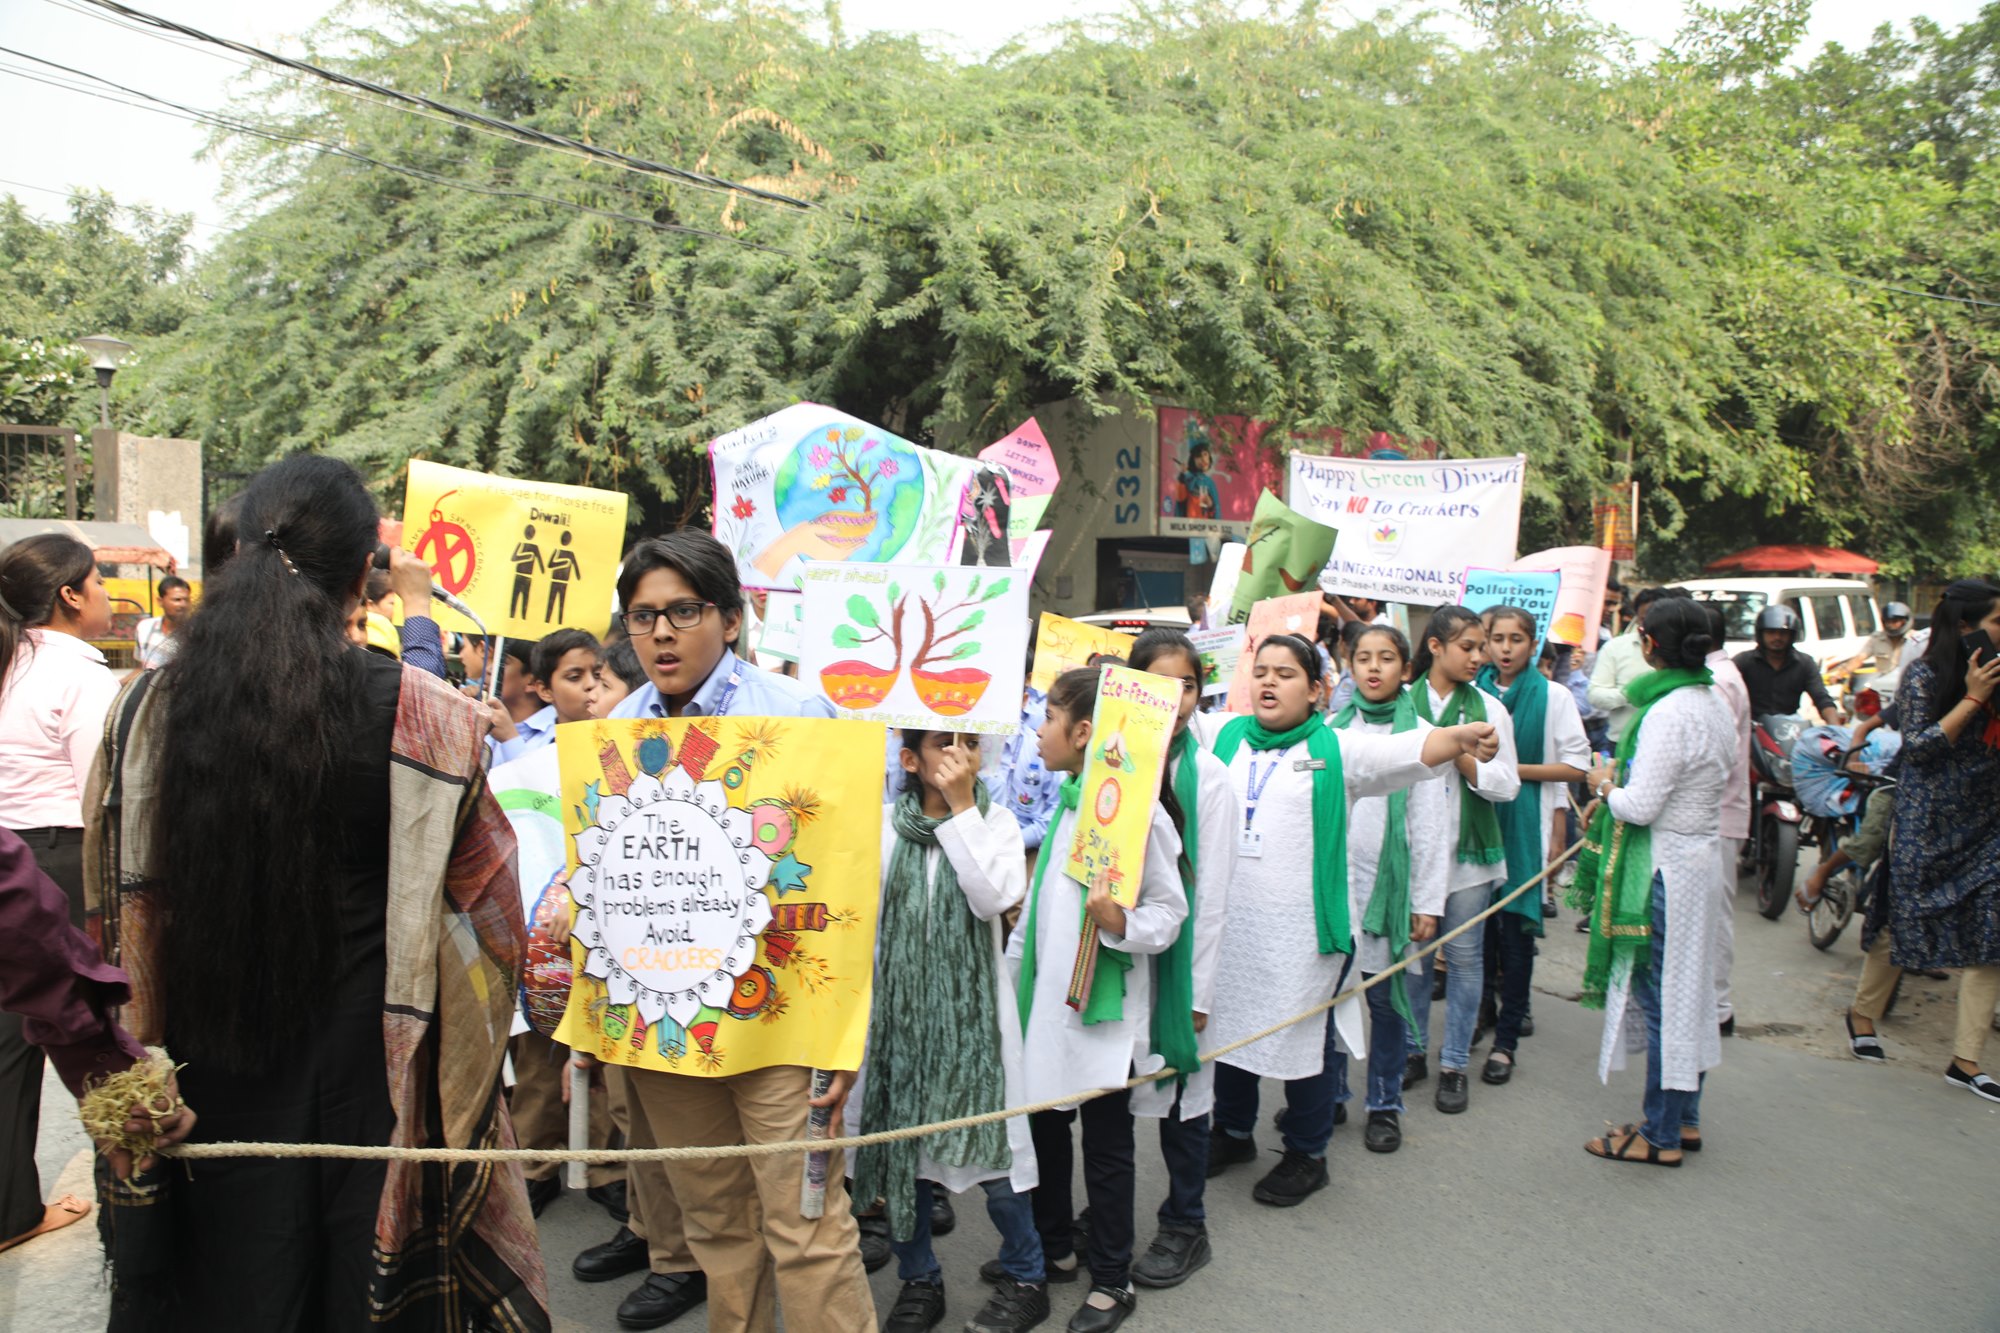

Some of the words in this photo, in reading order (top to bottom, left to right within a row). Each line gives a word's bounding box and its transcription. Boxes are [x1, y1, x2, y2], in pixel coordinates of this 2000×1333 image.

[1115, 446, 1141, 524] 532
[1299, 459, 1356, 493] Happy
[1360, 467, 1427, 490] Green
[1432, 463, 1519, 494] Diwali
[534, 489, 553, 502] for
[591, 500, 615, 515] free
[1346, 496, 1370, 514] NO
[1372, 500, 1393, 515] To
[1398, 501, 1481, 519] Crackers
[1342, 561, 1443, 584] INTERNATIONAL
[1382, 583, 1420, 595] ASHOK
[1423, 587, 1457, 599] VIHAR
[1518, 597, 1550, 609] You
[643, 813, 685, 836] The
[622, 835, 700, 862] EARTH
[603, 867, 643, 891] has
[652, 865, 722, 897] enough
[603, 895, 676, 927] problems
[681, 890, 741, 919] already
[641, 920, 695, 946] Avoid
[623, 946, 725, 972] CRACKERS
